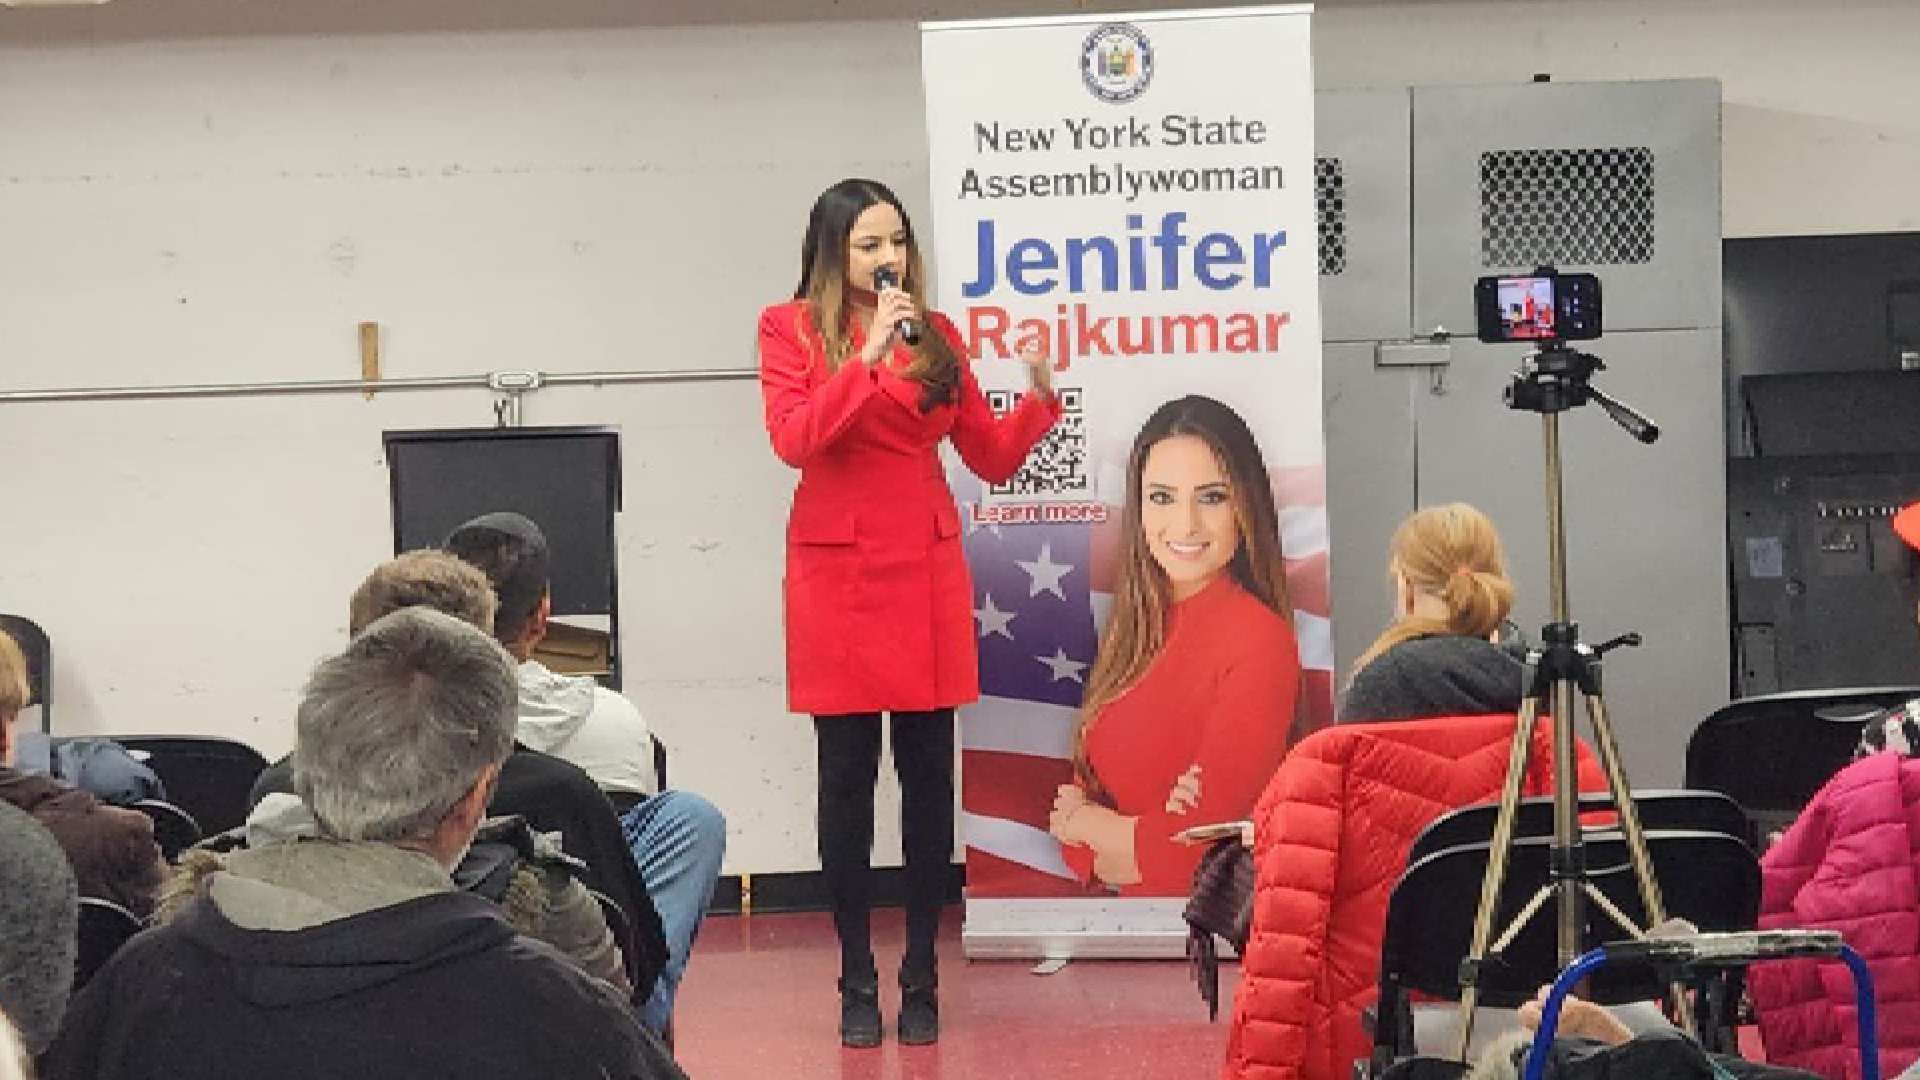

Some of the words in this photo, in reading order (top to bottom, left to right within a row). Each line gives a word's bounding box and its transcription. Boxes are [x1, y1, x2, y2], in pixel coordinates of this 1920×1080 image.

[974, 121, 1055, 153] New
[1063, 117, 1151, 151] York
[1161, 115, 1267, 146] State
[959, 163, 1284, 201] Assemblywoman
[961, 211, 1287, 298] Jenifer
[966, 303, 1291, 371] Rajkumar
[973, 504, 1038, 522] Learn
[1045, 505, 1107, 522] more
